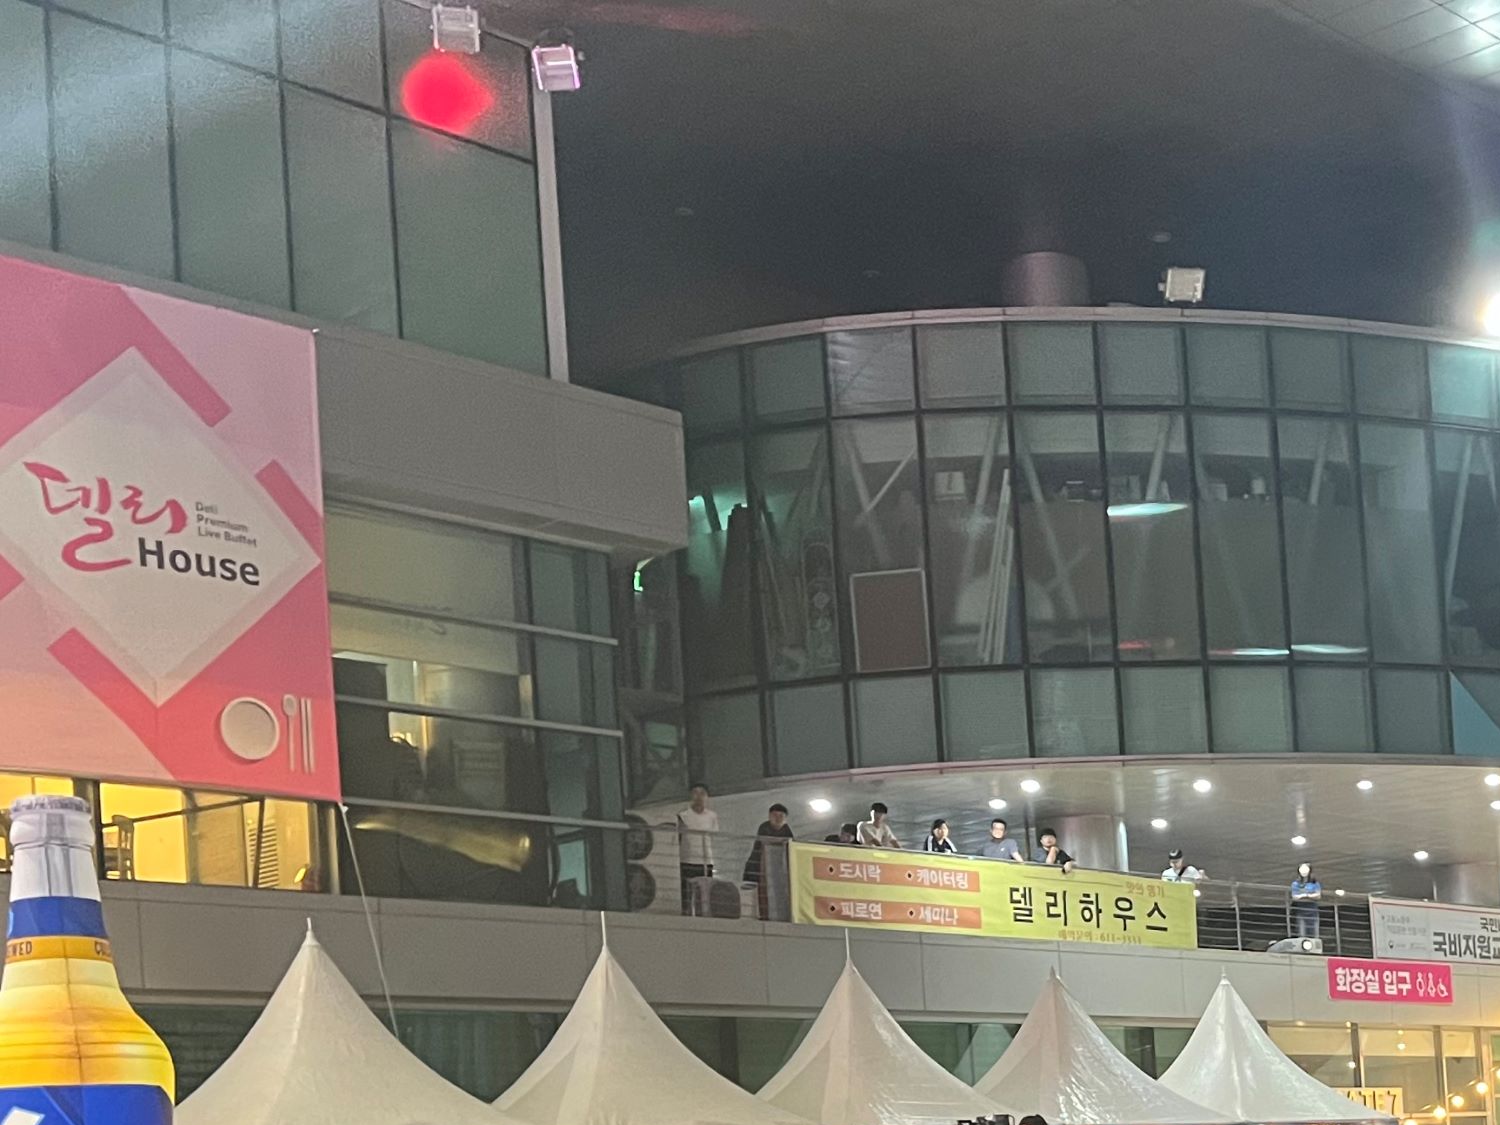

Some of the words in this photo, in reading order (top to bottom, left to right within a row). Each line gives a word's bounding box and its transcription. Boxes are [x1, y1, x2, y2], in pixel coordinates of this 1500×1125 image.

[23, 461, 188, 572] 델리
[138, 537, 261, 586] House
[839, 863, 881, 882] 도시락
[919, 906, 959, 926] 세미나
[1009, 886, 1169, 932] 델리하우스
[1335, 967, 1381, 994] 화장실
[1383, 970, 1412, 996] 입구
